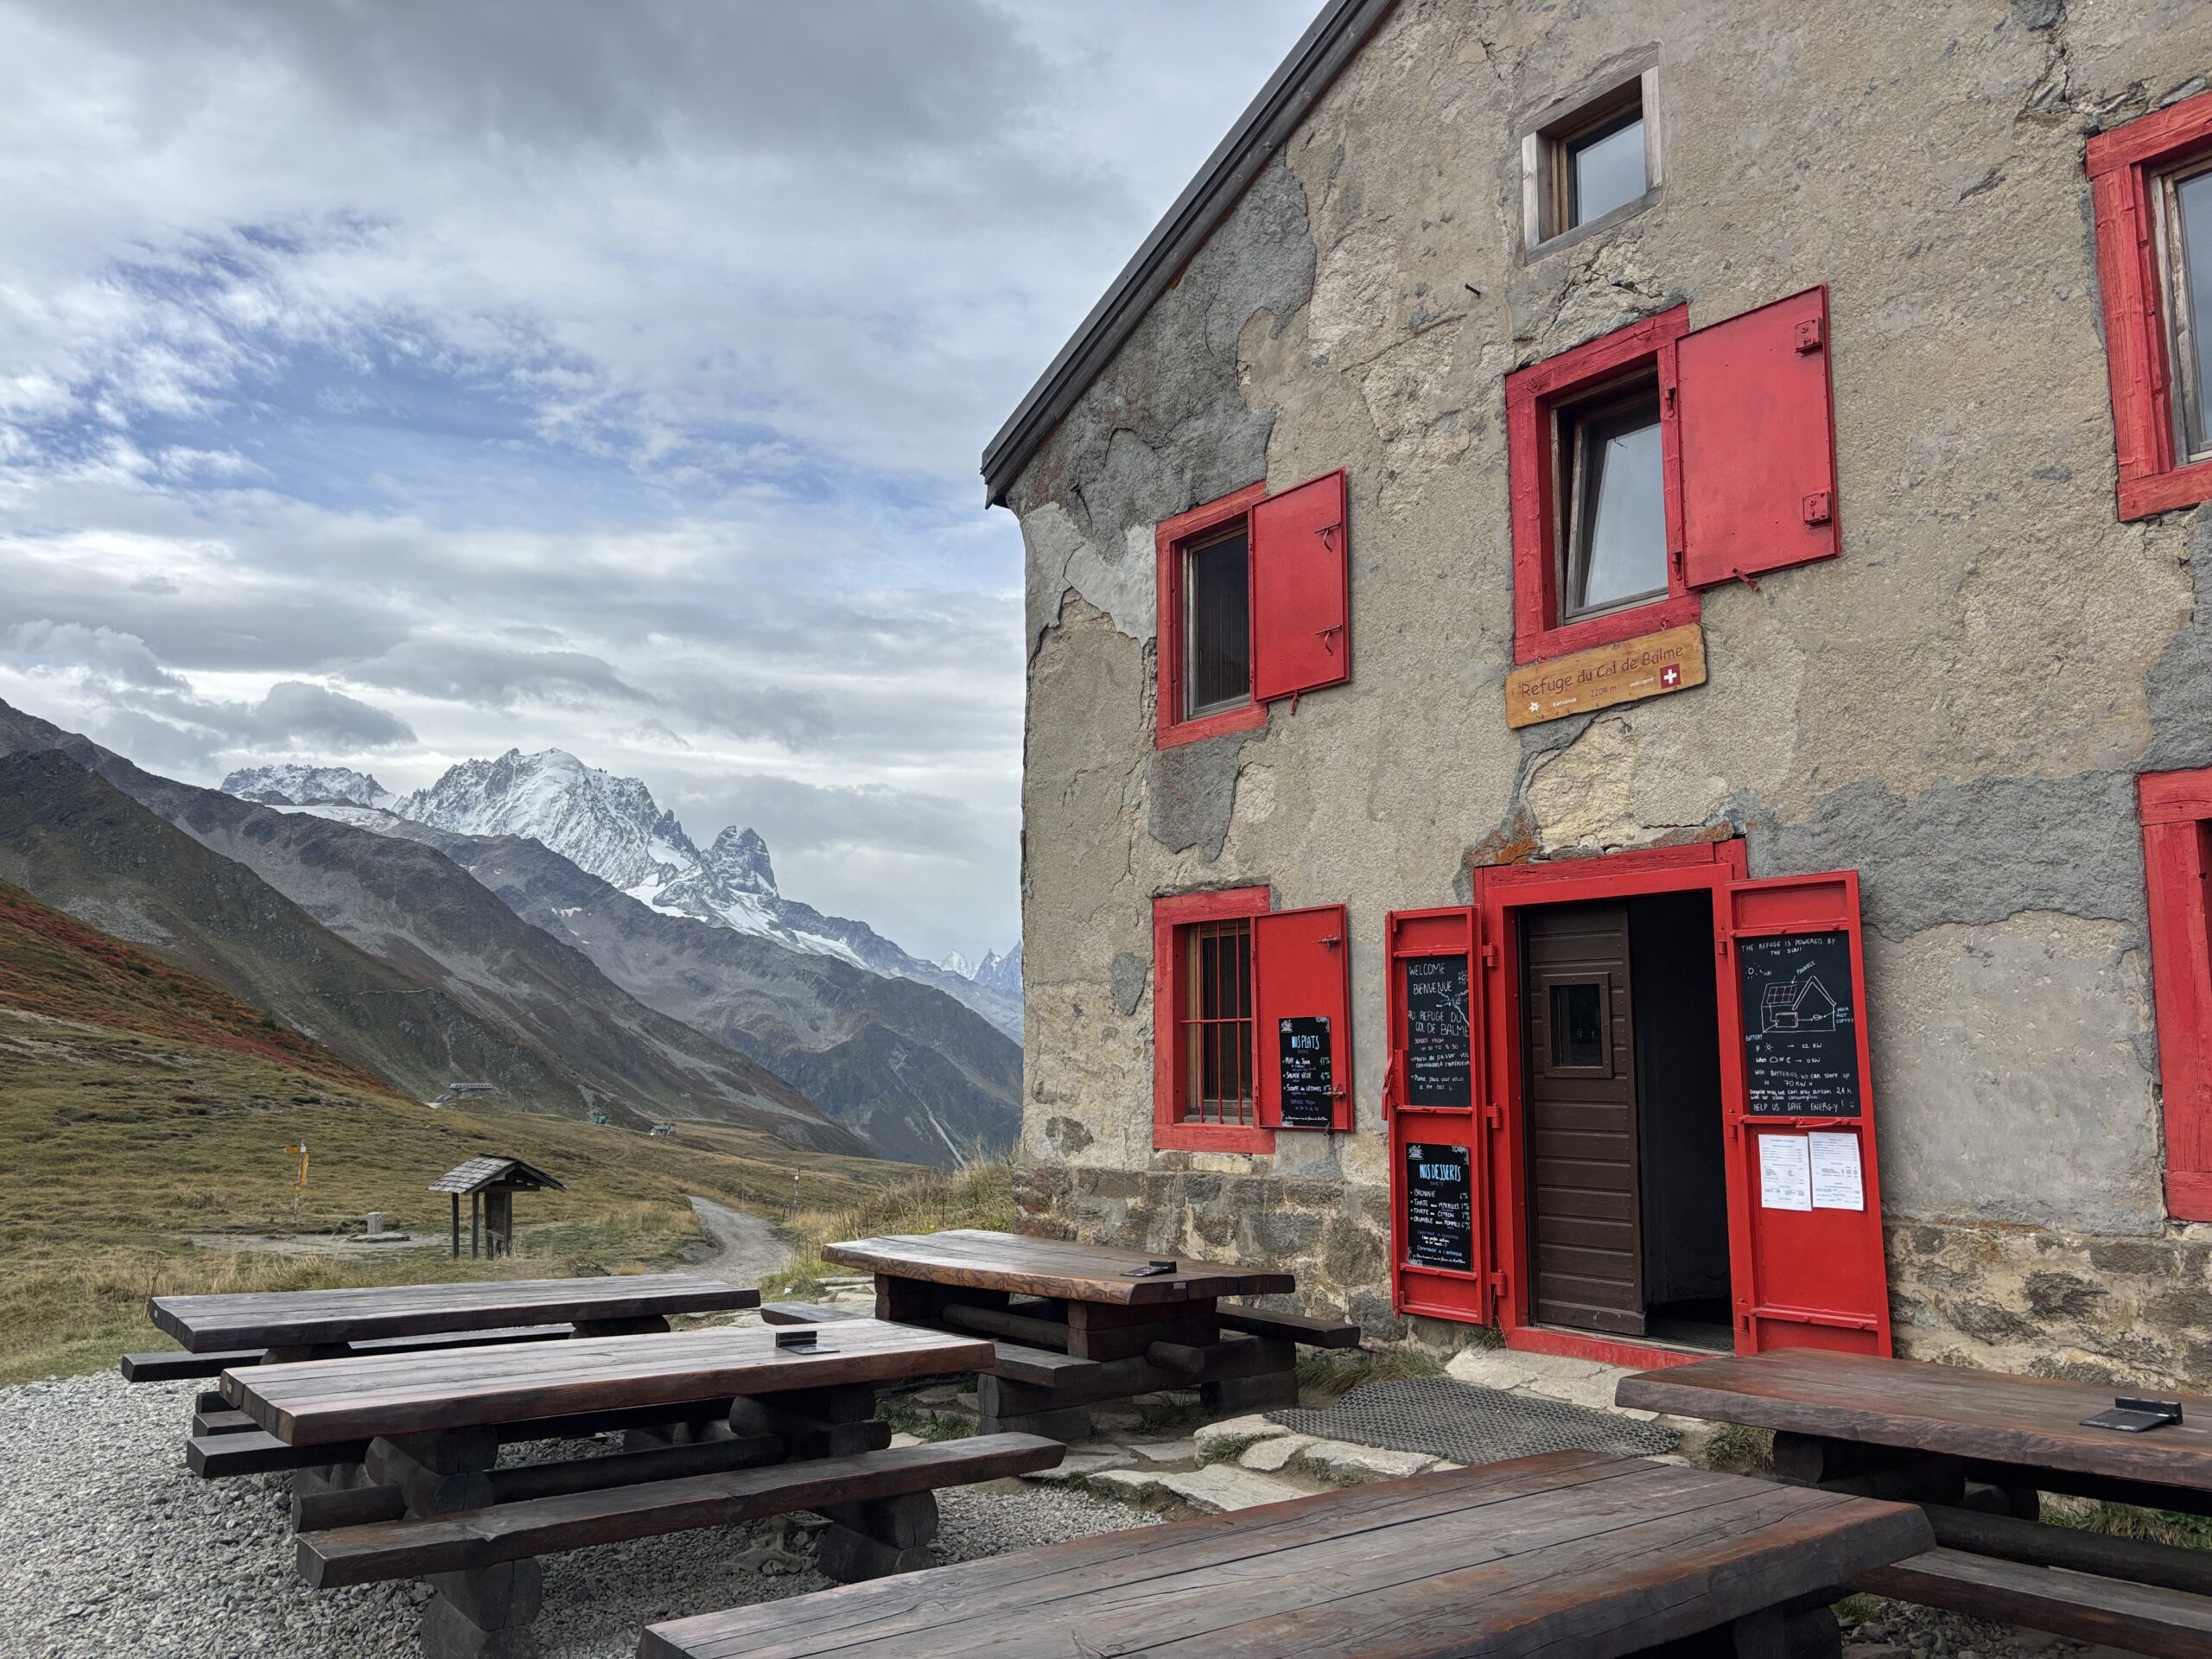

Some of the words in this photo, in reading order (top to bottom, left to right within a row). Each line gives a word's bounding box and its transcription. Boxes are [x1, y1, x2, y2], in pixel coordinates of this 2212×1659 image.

[1522, 677, 1573, 698] Refuge
[1576, 669, 1592, 683] du
[1596, 660, 1617, 679] Col
[1621, 657, 1638, 671] de
[1642, 646, 1685, 671] Balme
[1759, 941, 1781, 950] REFUGE
[1827, 938, 1836, 946] BY
[1409, 963, 1446, 976] WELCOME
[1413, 982, 1452, 995] BIENVENUE
[1408, 1010, 1416, 1020] AU
[1420, 1011, 1445, 1022] REFUGE
[1451, 1012, 1462, 1023] DU
[1440, 1024, 1470, 1038] BALME
[1301, 1035, 1320, 1050] PLATS
[1835, 1086, 1846, 1095] 24
[1753, 1103, 1768, 1111] HELP
[1771, 1103, 1780, 1111] US
[1787, 1103, 1802, 1111] SAVE
[1431, 1164, 1461, 1182] DESSERTS
